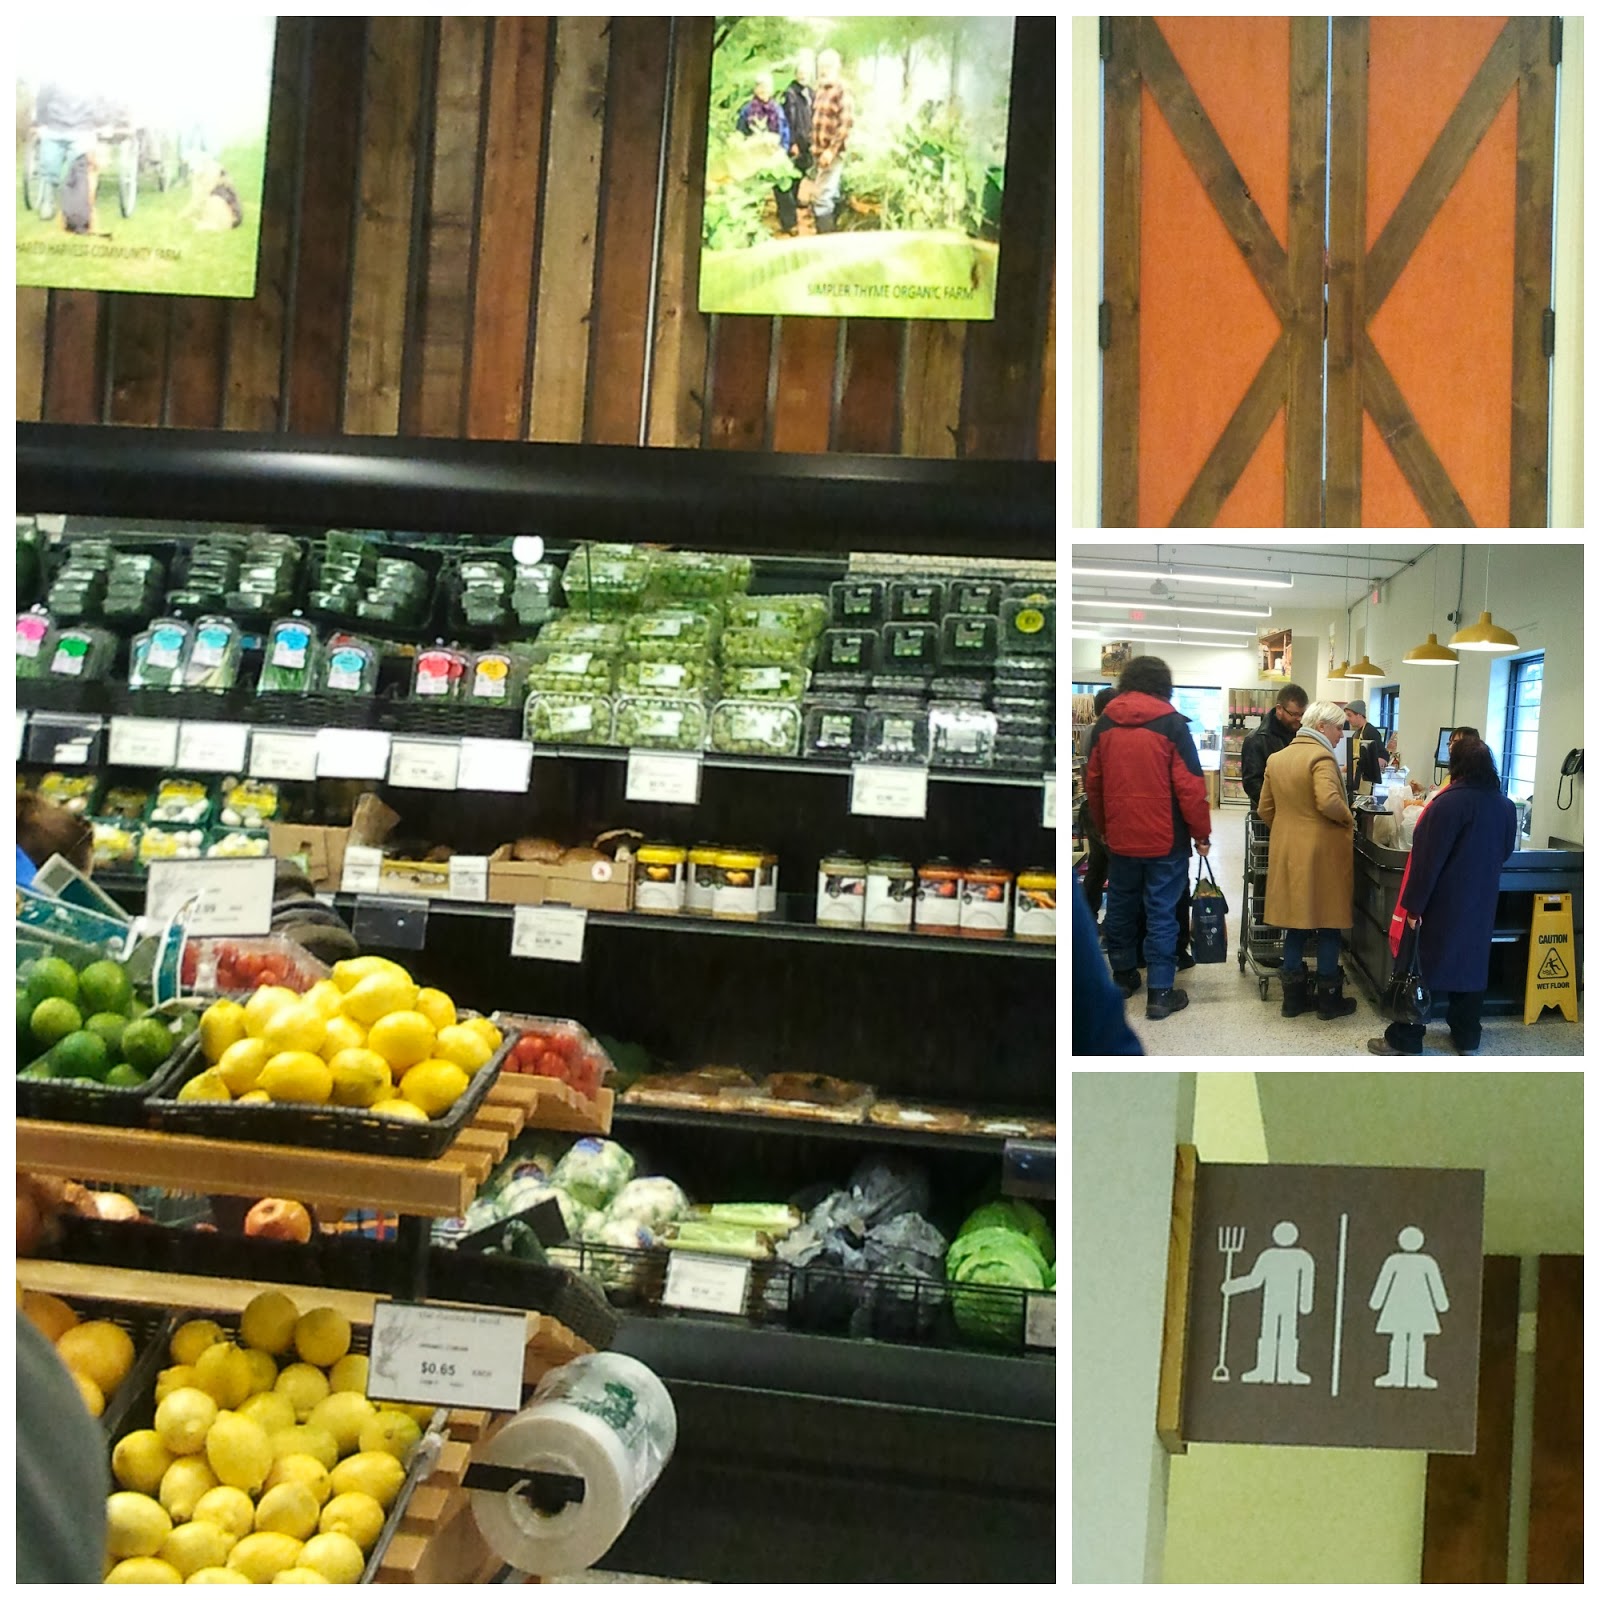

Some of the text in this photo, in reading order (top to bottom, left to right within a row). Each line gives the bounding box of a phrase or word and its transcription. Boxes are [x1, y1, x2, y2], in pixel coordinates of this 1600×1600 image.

[91, 245, 151, 260] COMMUNITY
[155, 248, 181, 261] FARM
[807, 283, 974, 301] SIMPLER THYME ORGANIC FARM
[1538, 934, 1568, 944] CAUTION
[421, 1361, 456, 1376] $0.65
